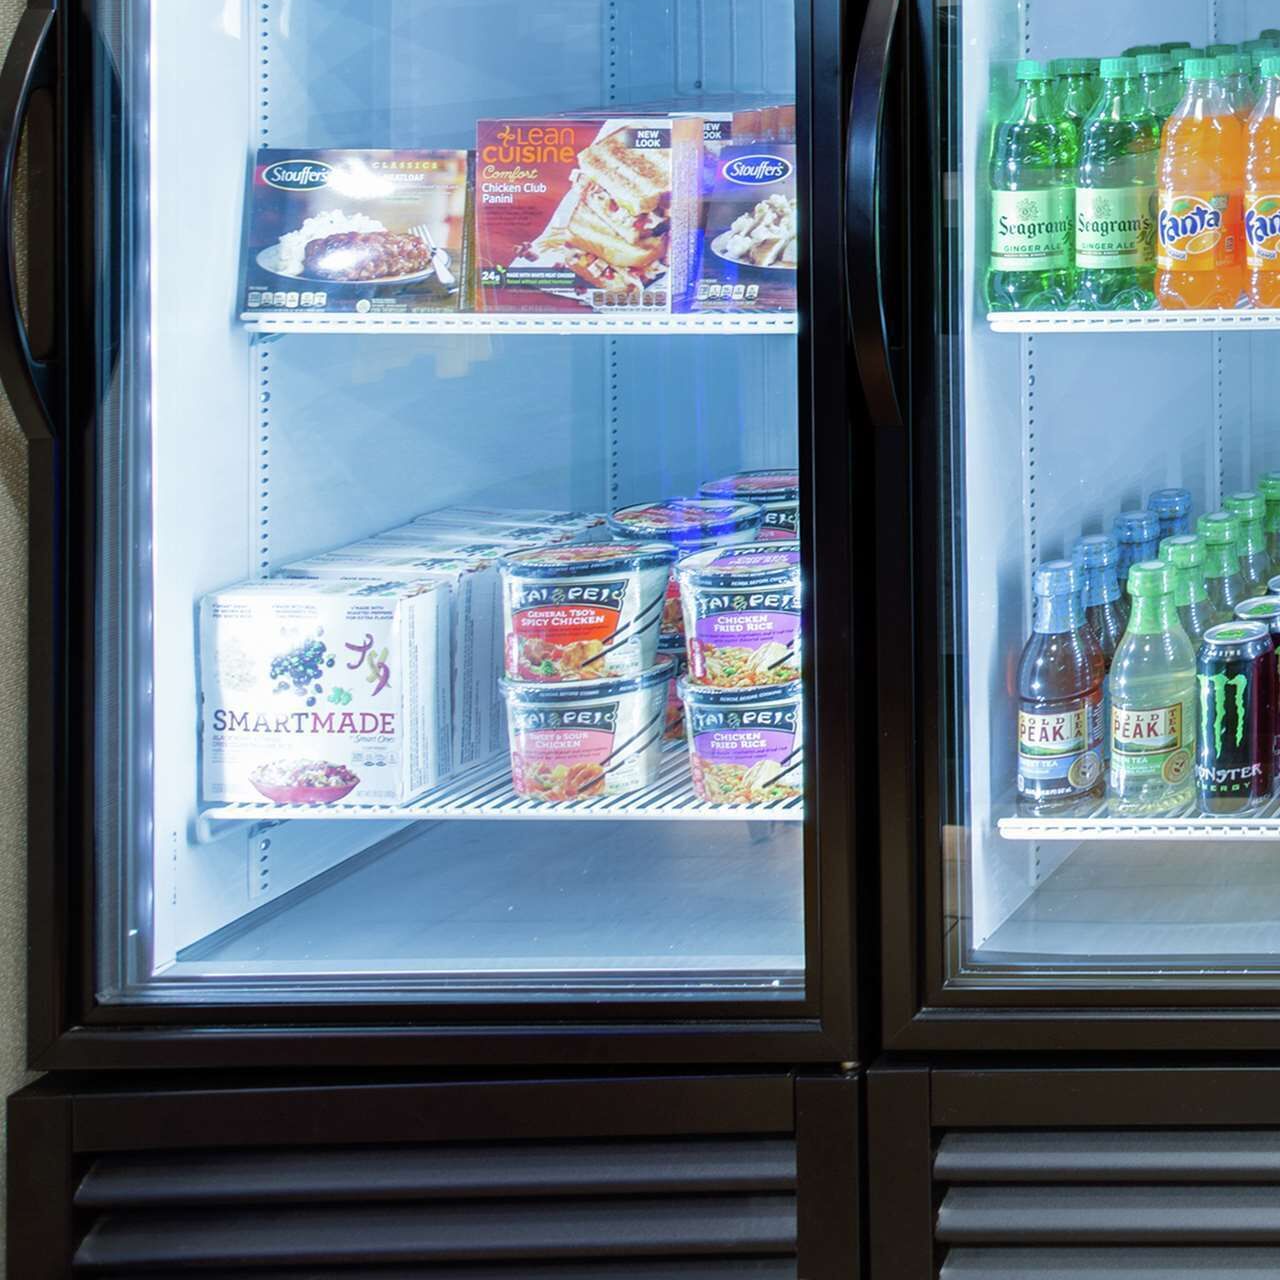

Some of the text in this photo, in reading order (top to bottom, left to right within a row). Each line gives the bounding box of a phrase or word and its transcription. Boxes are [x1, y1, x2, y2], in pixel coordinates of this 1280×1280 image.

[637, 130, 660, 139] NEW
[635, 139, 661, 148] LOOK
[482, 165, 539, 181] Comfort
[728, 159, 784, 178] Stouffer's
[270, 166, 328, 184] Stouffer's
[482, 182, 547, 194] Chicken Club
[482, 193, 513, 204] Panini
[999, 215, 1073, 239] Seagram's
[1078, 215, 1150, 238] Seagram's
[1003, 245, 1038, 253] GINGER
[1116, 241, 1137, 250] ALE
[527, 609, 568, 618] GENERAL
[521, 615, 605, 626] SPICY CHICKEN
[717, 615, 769, 624] CHICKEN
[714, 622, 774, 632] FRIED RICE
[213, 709, 395, 734] SMARTMADE
[1019, 725, 1065, 742] PEAK
[1113, 720, 1160, 739] PEAK
[713, 732, 761, 741] CHICKEN
[711, 739, 767, 750] FRIED RICE
